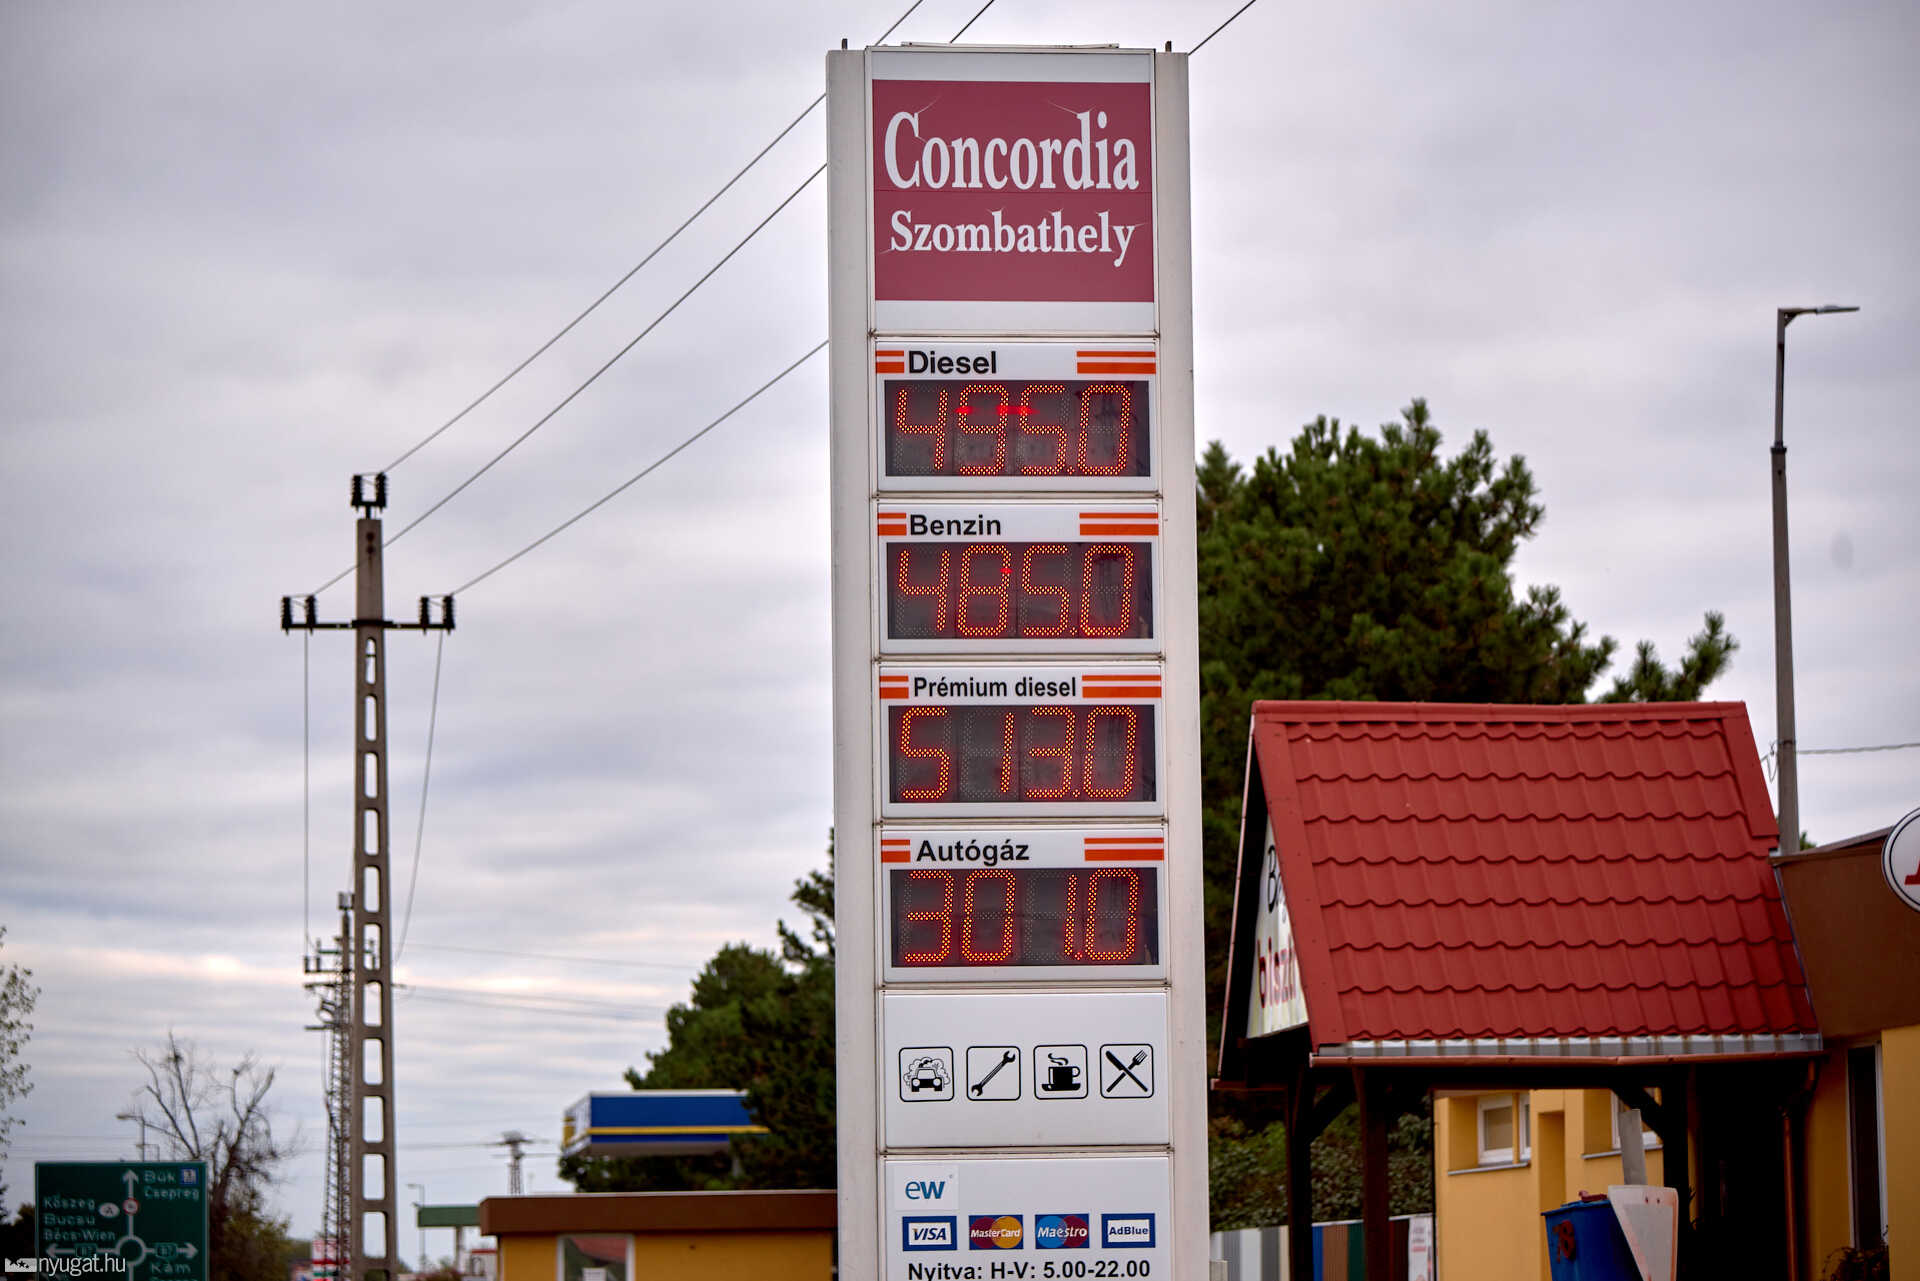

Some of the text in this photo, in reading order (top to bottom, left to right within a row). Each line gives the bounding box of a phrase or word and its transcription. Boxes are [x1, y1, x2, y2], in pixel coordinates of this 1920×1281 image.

[884, 111, 1139, 190] Concordia
[890, 210, 1136, 267] Szombathely
[907, 350, 997, 374] Diesel
[896, 384, 1132, 476] 495.0
[909, 514, 1002, 536] Benzin
[898, 544, 1134, 637] 485.0
[913, 676, 1077, 697] Prémium diesel
[900, 706, 1137, 799] 513.0
[916, 838, 1030, 867] Autógáz
[904, 868, 1139, 962] 301.0
[905, 1180, 946, 1200] ew
[912, 1227, 947, 1241] VISA
[970, 1228, 1021, 1238] MasterCard
[1037, 1225, 1088, 1238] Maestro
[1108, 1226, 1149, 1236] AdBlue
[908, 1259, 1150, 1281] Nyitva: H-V: 5.00-22.00
